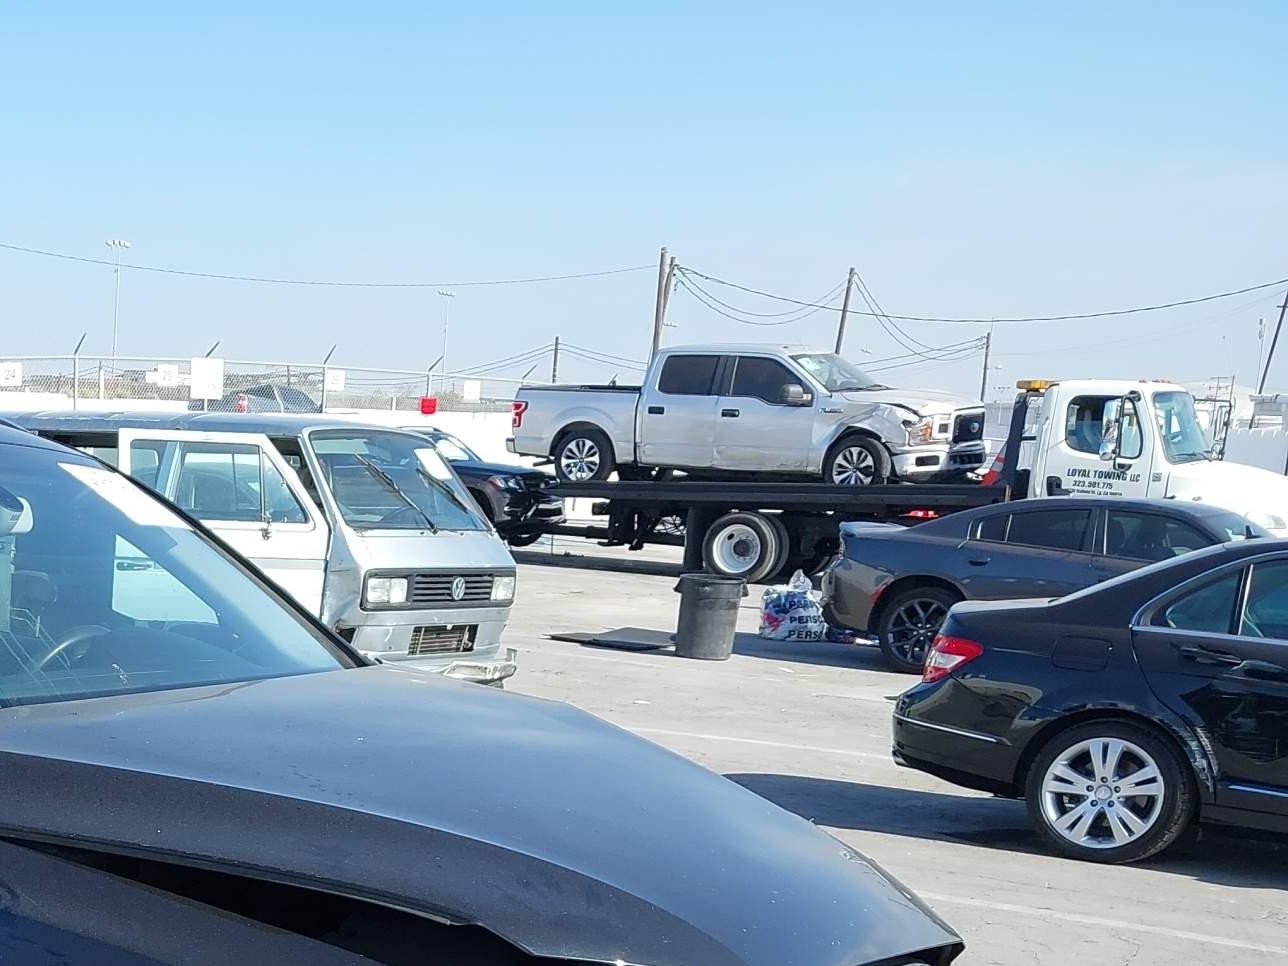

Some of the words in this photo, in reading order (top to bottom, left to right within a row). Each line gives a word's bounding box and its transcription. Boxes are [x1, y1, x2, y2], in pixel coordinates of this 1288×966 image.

[1067, 469, 1090, 478] LOYAL
[1093, 470, 1127, 481] TOWING
[1129, 473, 1141, 483] LLC
